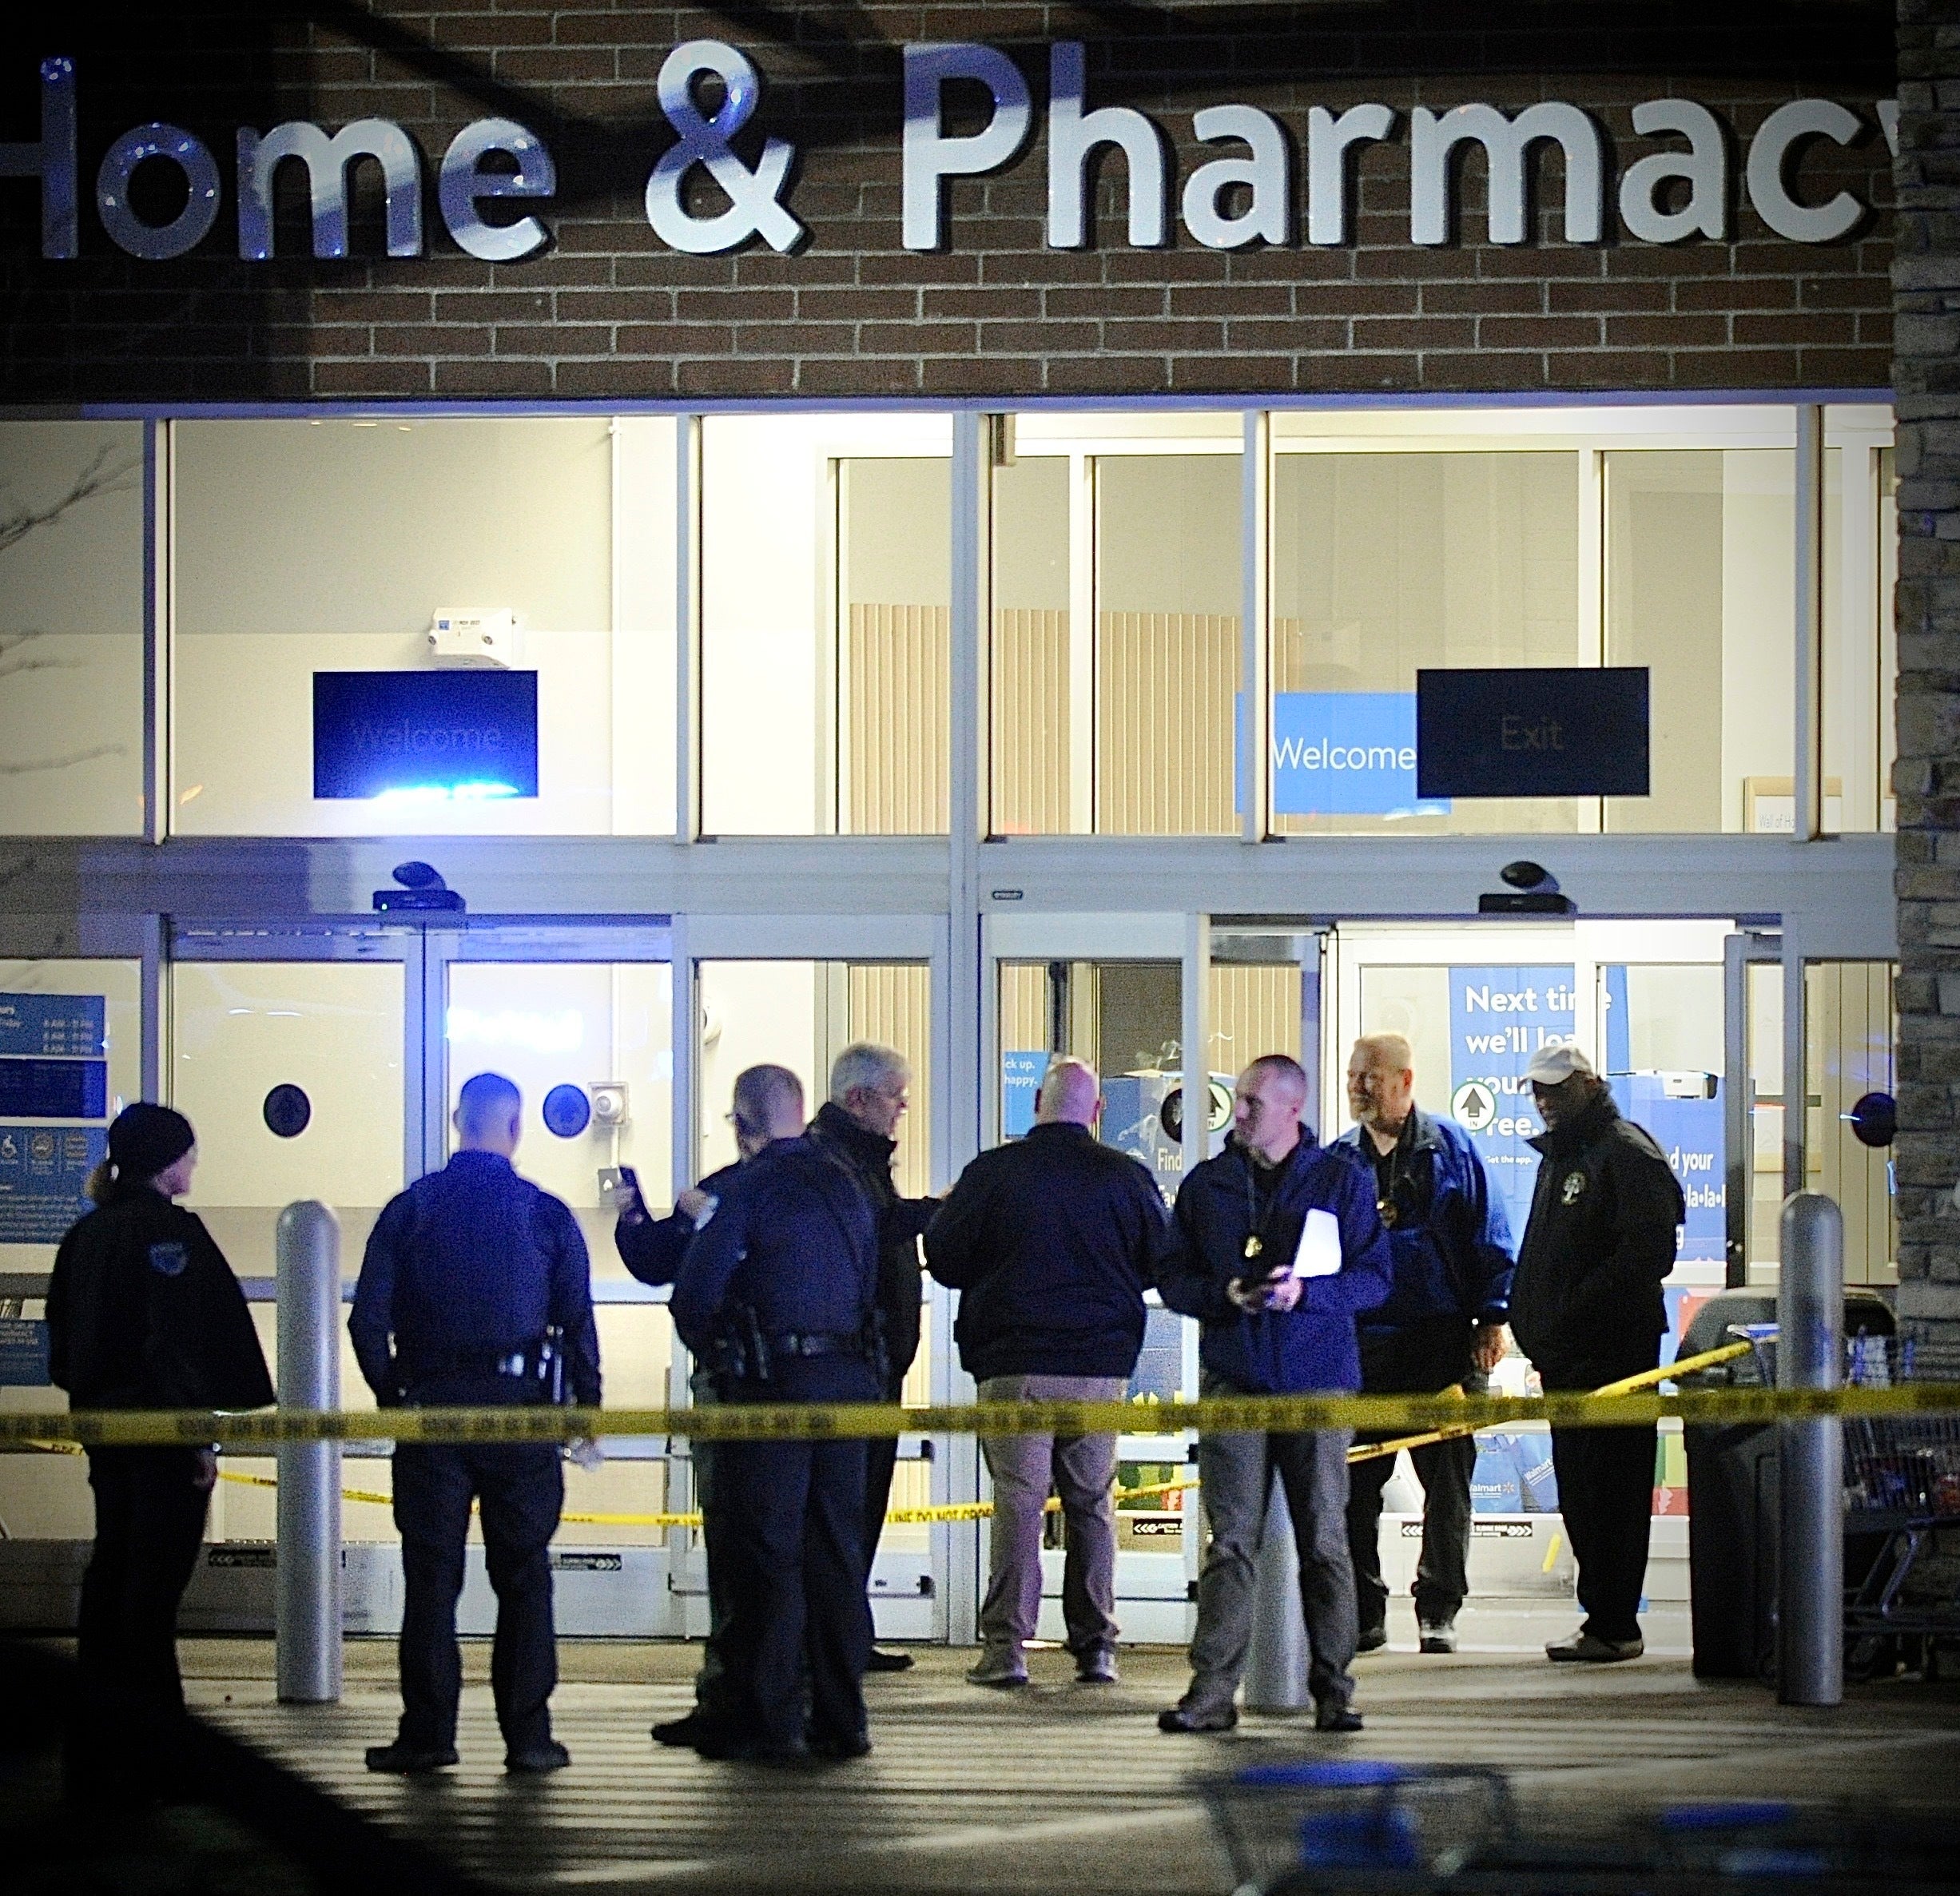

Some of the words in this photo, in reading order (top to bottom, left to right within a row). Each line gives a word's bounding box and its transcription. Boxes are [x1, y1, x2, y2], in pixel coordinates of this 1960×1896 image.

[645, 39, 805, 256] &
[902, 41, 1899, 251] Pharmac
[349, 718, 502, 753] Welcome
[1500, 716, 1565, 752] Exit
[1274, 737, 1416, 771] Welcome
[1465, 985, 1538, 1012] Next
[1546, 984, 1612, 1012] tie
[1004, 1059, 1017, 1069] ck
[1020, 1060, 1036, 1072] up.
[1004, 1074, 1038, 1087] happy.
[1466, 1076, 1528, 1095] our
[1158, 1147, 1183, 1171] Find
[1501, 1155, 1514, 1163] the
[1516, 1156, 1533, 1165] app.
[1682, 1152, 1714, 1178] your
